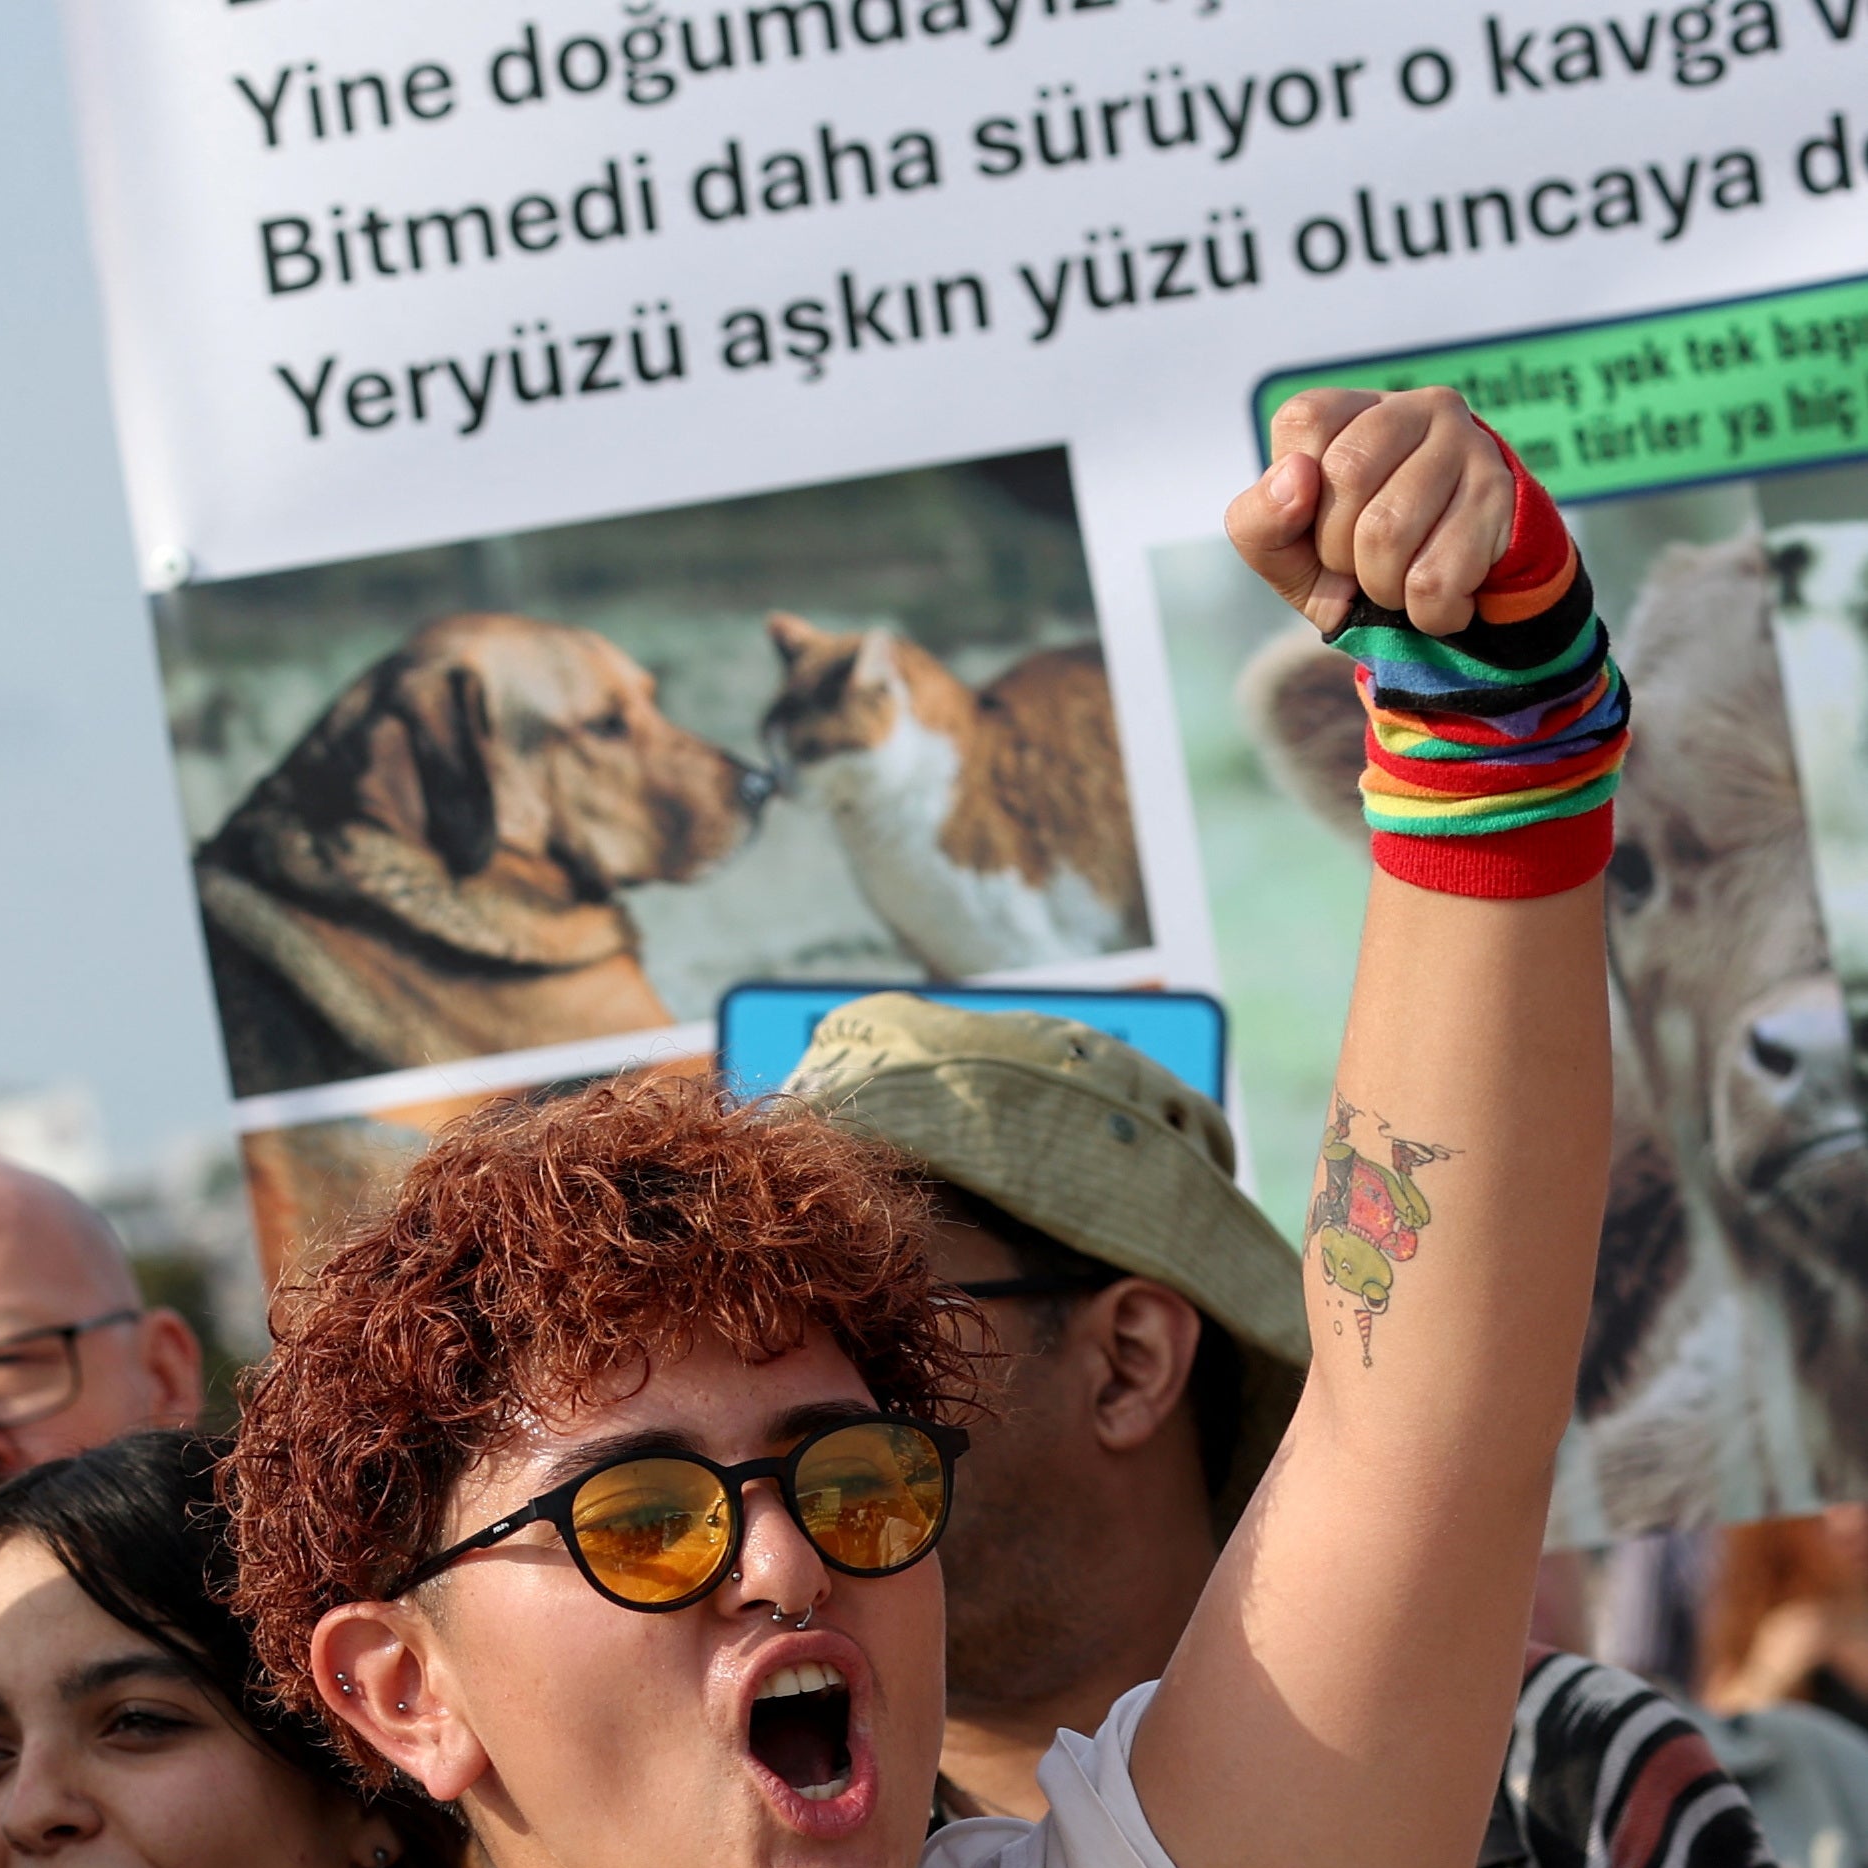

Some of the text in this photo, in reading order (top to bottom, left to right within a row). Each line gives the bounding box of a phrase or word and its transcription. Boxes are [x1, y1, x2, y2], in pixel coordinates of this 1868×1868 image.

[232, 0, 1116, 150] Yine doğumday
[258, 153, 661, 296] Bitmedi
[690, 123, 943, 223] daha
[973, 58, 1366, 179] sürüyor
[1399, 44, 1454, 108] o
[1485, 0, 1781, 96] kavga
[276, 111, 1868, 439] Yeryüzü aşkın yüzü oluncaya d
[1684, 326, 1759, 375] tek
